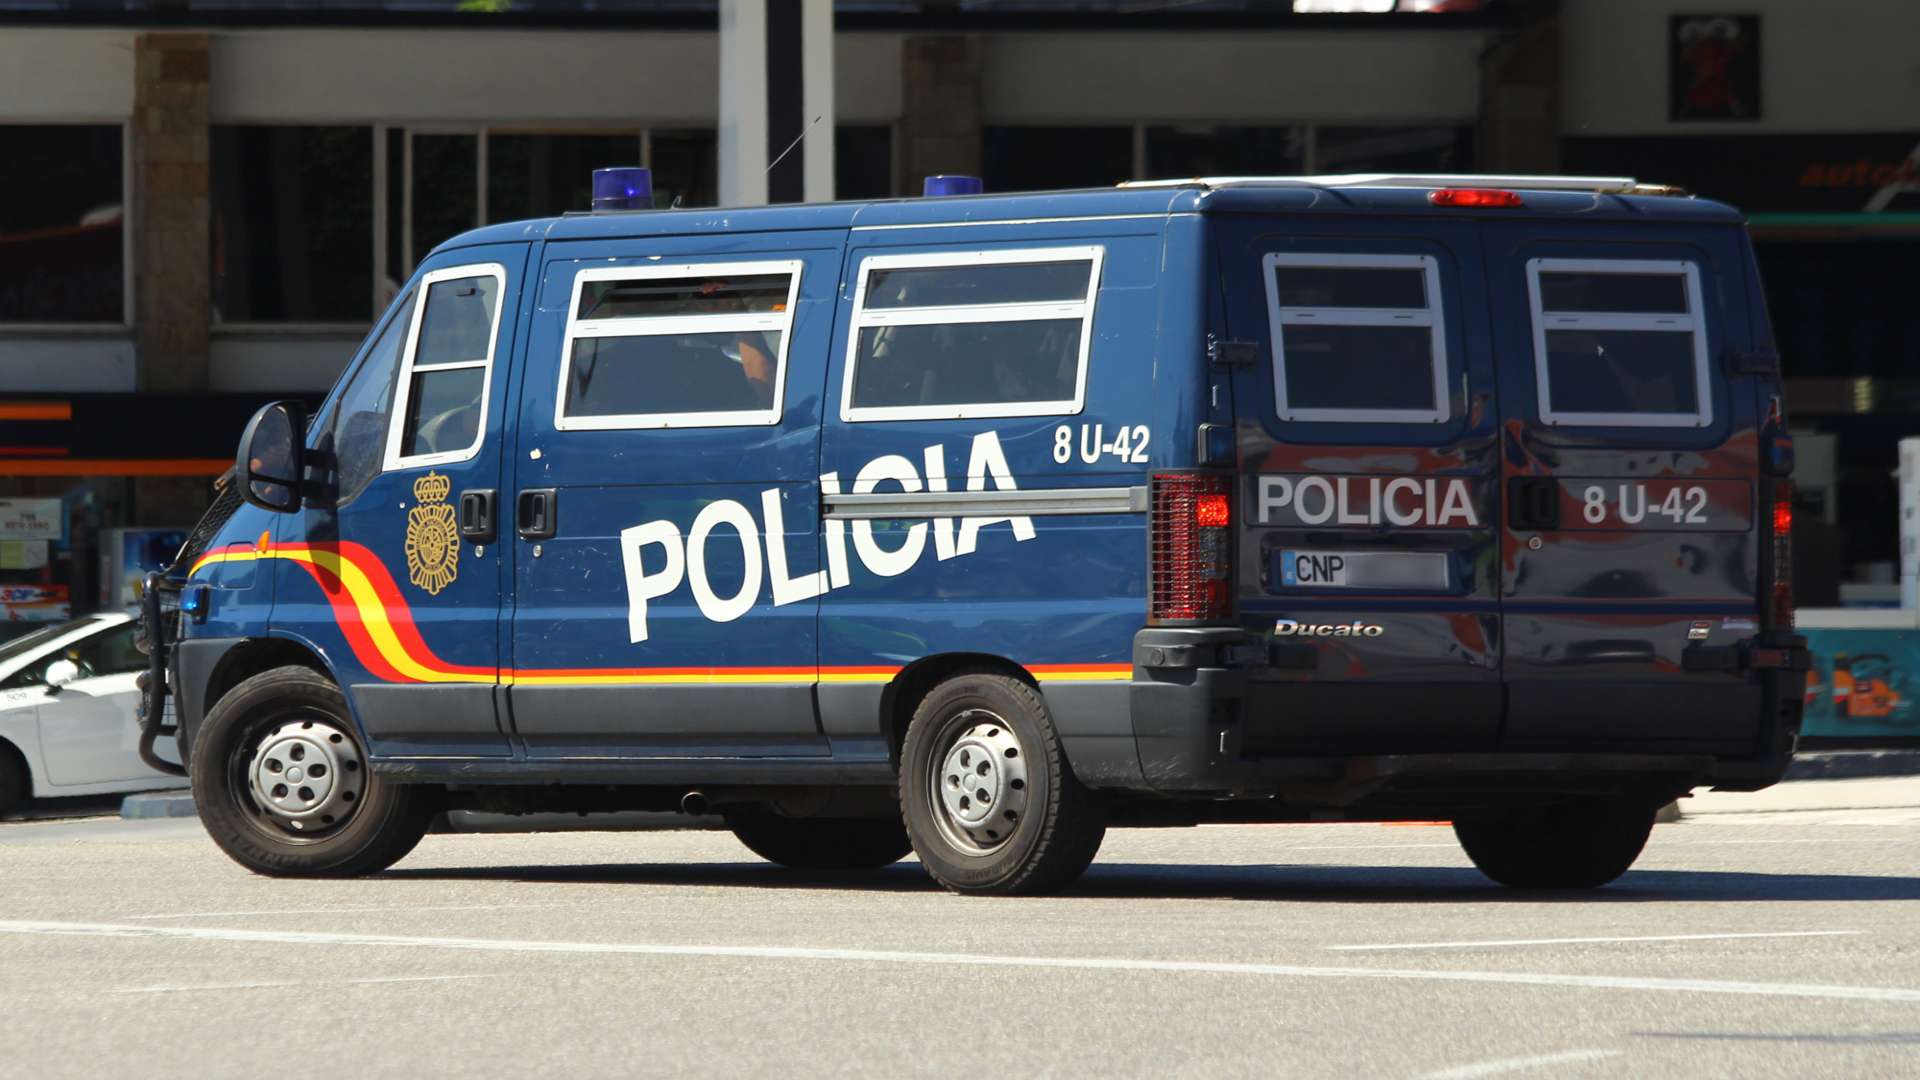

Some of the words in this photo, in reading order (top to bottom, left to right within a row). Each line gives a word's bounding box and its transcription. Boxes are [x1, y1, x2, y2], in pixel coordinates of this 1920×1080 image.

[1053, 424, 1072, 464] 8
[1081, 424, 1150, 464] U-42
[1258, 475, 1478, 526] POLICIA
[1583, 485, 1606, 524] 8
[1619, 484, 1707, 524] U-42
[621, 431, 1036, 643] POLICIA
[1296, 555, 1344, 583] CNP
[1274, 619, 1384, 637] Ducato
